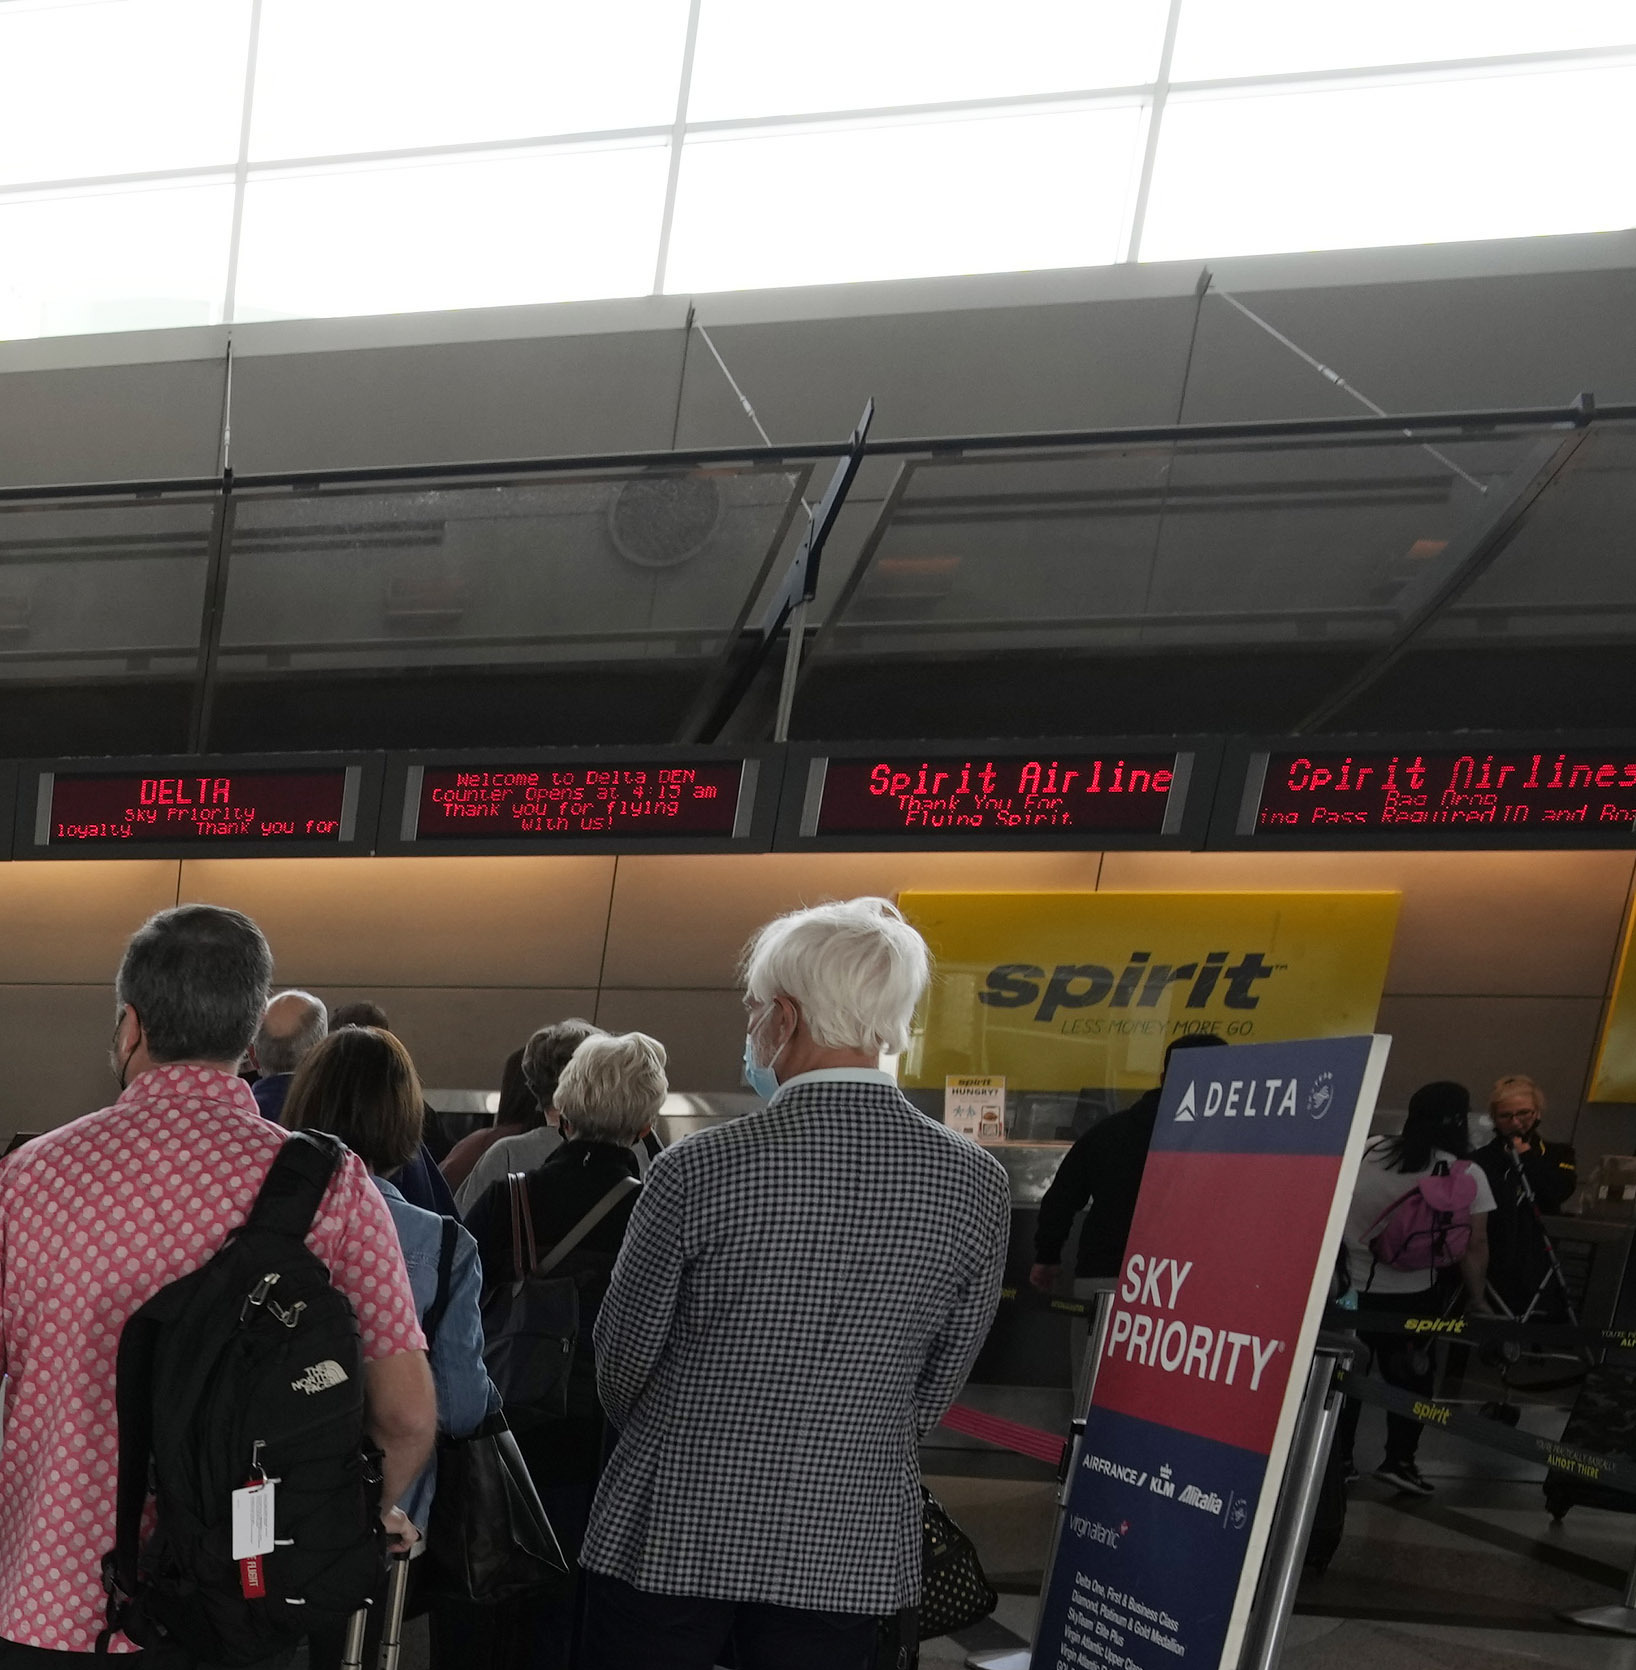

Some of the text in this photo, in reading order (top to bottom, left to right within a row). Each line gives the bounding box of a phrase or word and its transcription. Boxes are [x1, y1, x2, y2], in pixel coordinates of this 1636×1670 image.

[456, 769, 696, 787] Welcome to Delta DEN
[869, 760, 1173, 796] Spirit Airline
[140, 778, 231, 805] DELTA
[432, 784, 719, 803] Counter Opens at 4:15 am
[894, 794, 1063, 812] Thank You For
[443, 800, 679, 818] Thank you for flying
[521, 816, 613, 831] with us!
[951, 1087, 999, 1096] HUNGRY?
[1203, 1077, 1298, 1118] DELTA
[1120, 1252, 1193, 1310] SKY
[1403, 1315, 1468, 1334] spirit
[1106, 1311, 1280, 1392] PRIORITY
[1411, 1400, 1453, 1426] spirit
[1547, 1454, 1577, 1473] ALMOST
[1576, 1462, 1601, 1480] THERE
[1082, 1453, 1224, 1516] AIRFRANCE KLM Alitalia
[1075, 1571, 1179, 1632] Delta One, First & Business Class
[1067, 1607, 1125, 1647] SkyTeam Elite Plus
[1071, 1589, 1185, 1657] Diamond, Platinum & Gold Medallion
